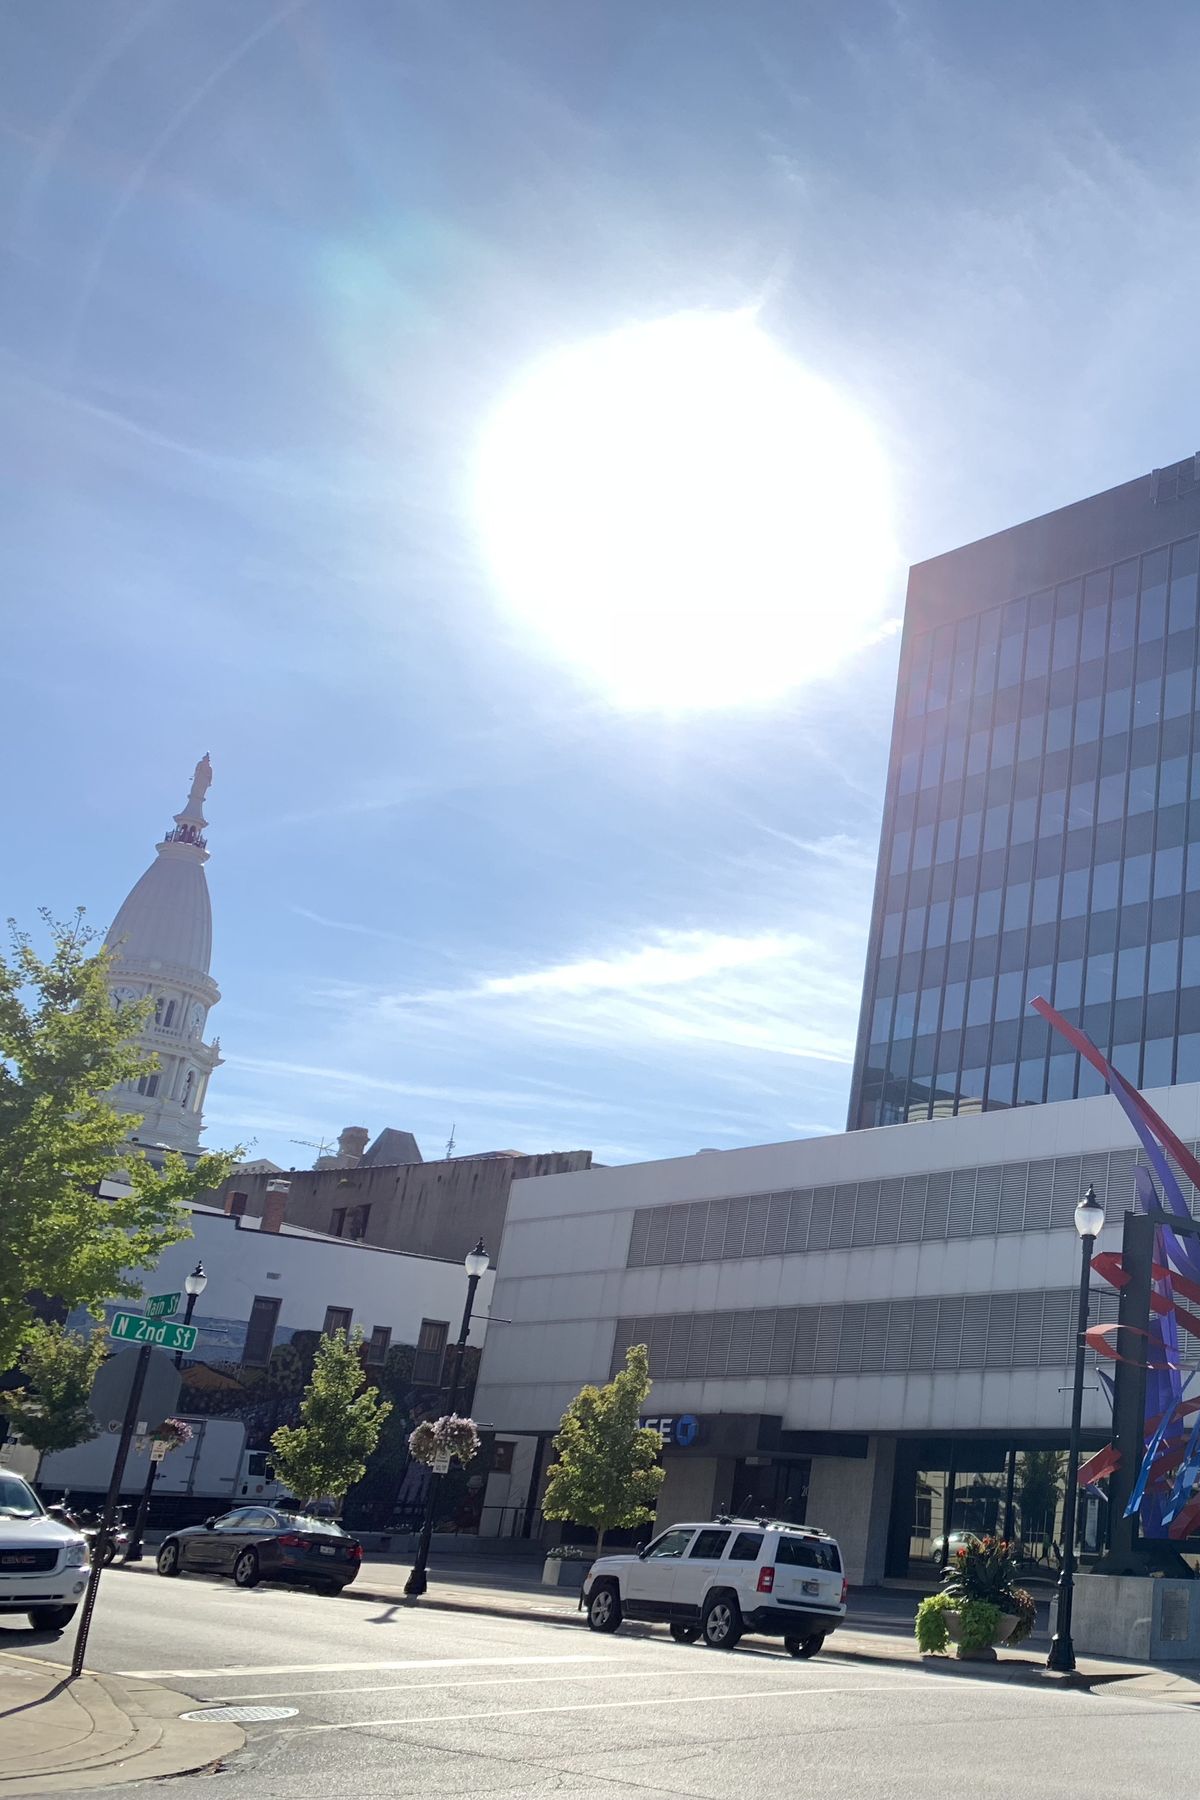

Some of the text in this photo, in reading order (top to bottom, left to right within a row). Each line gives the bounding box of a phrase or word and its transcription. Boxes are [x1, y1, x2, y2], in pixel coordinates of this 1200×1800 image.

[145, 1295, 179, 1317] Main St
[116, 1316, 191, 1348] N 2nd St
